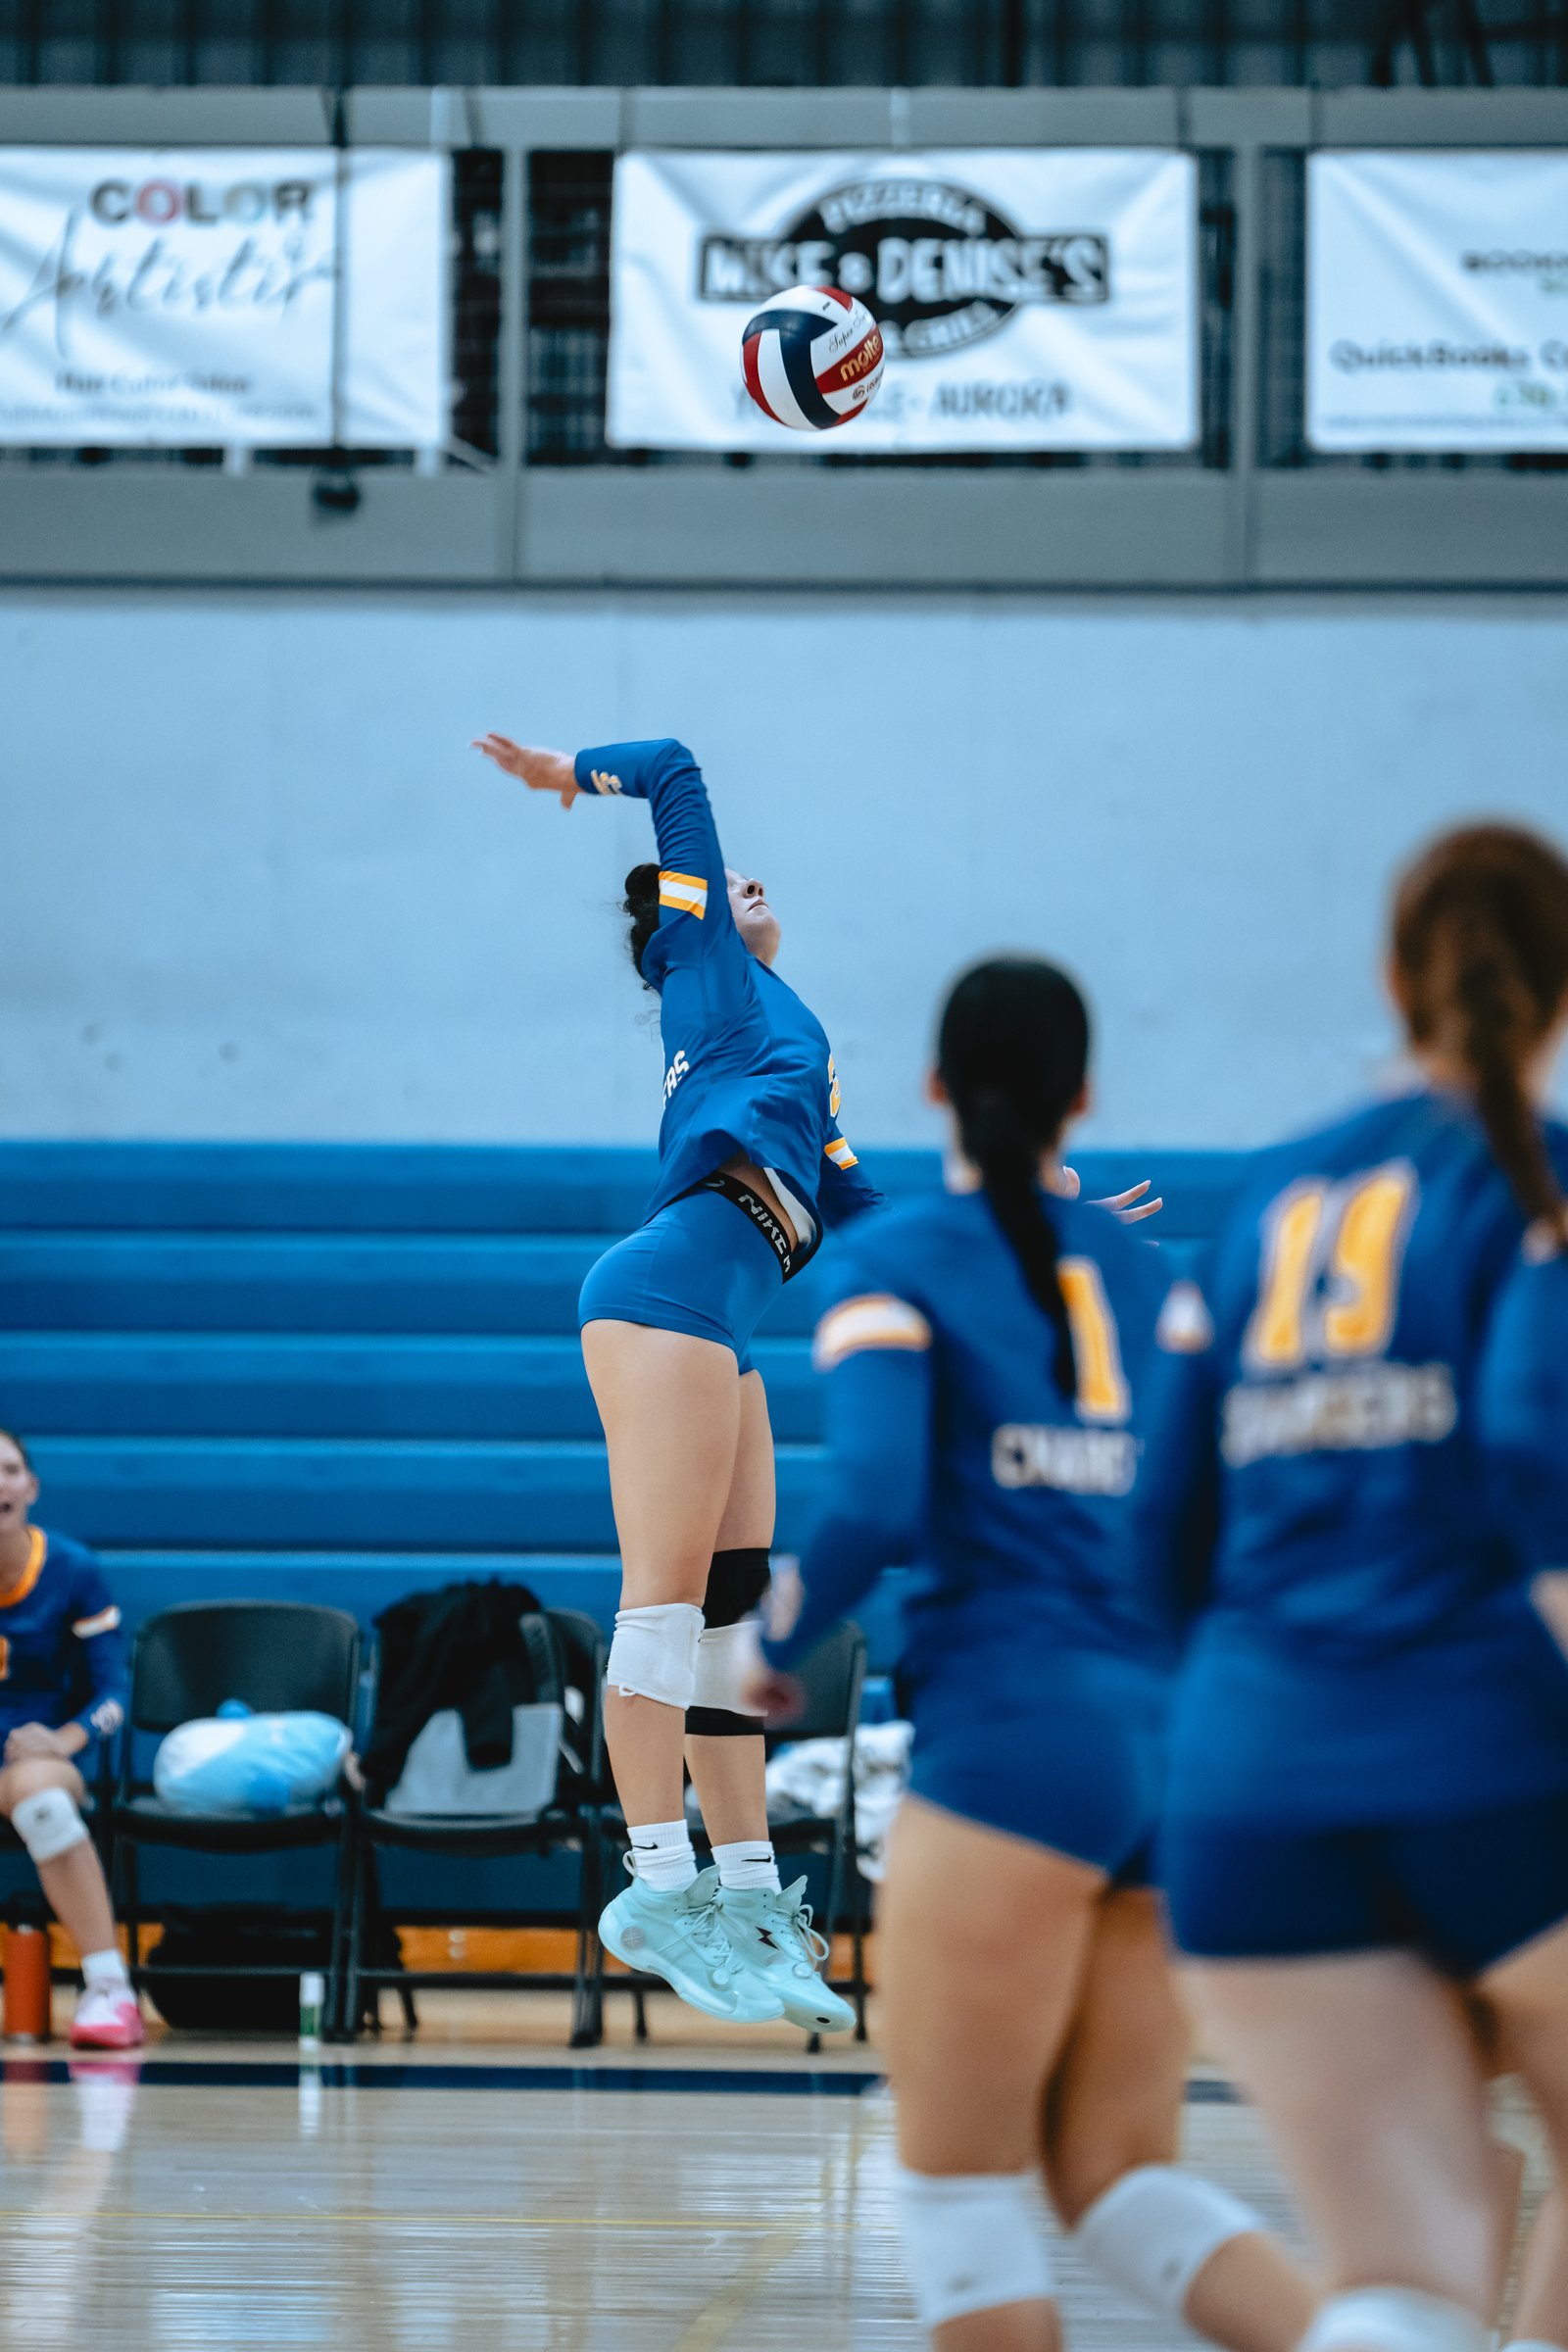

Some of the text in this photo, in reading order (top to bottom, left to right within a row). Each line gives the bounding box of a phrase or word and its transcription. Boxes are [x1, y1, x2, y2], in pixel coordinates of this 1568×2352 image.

[89, 178, 313, 227] COLOR
[875, 236, 1104, 304] DENISE'S
[840, 334, 882, 382] molte
[1057, 1254, 1133, 1423] 1
